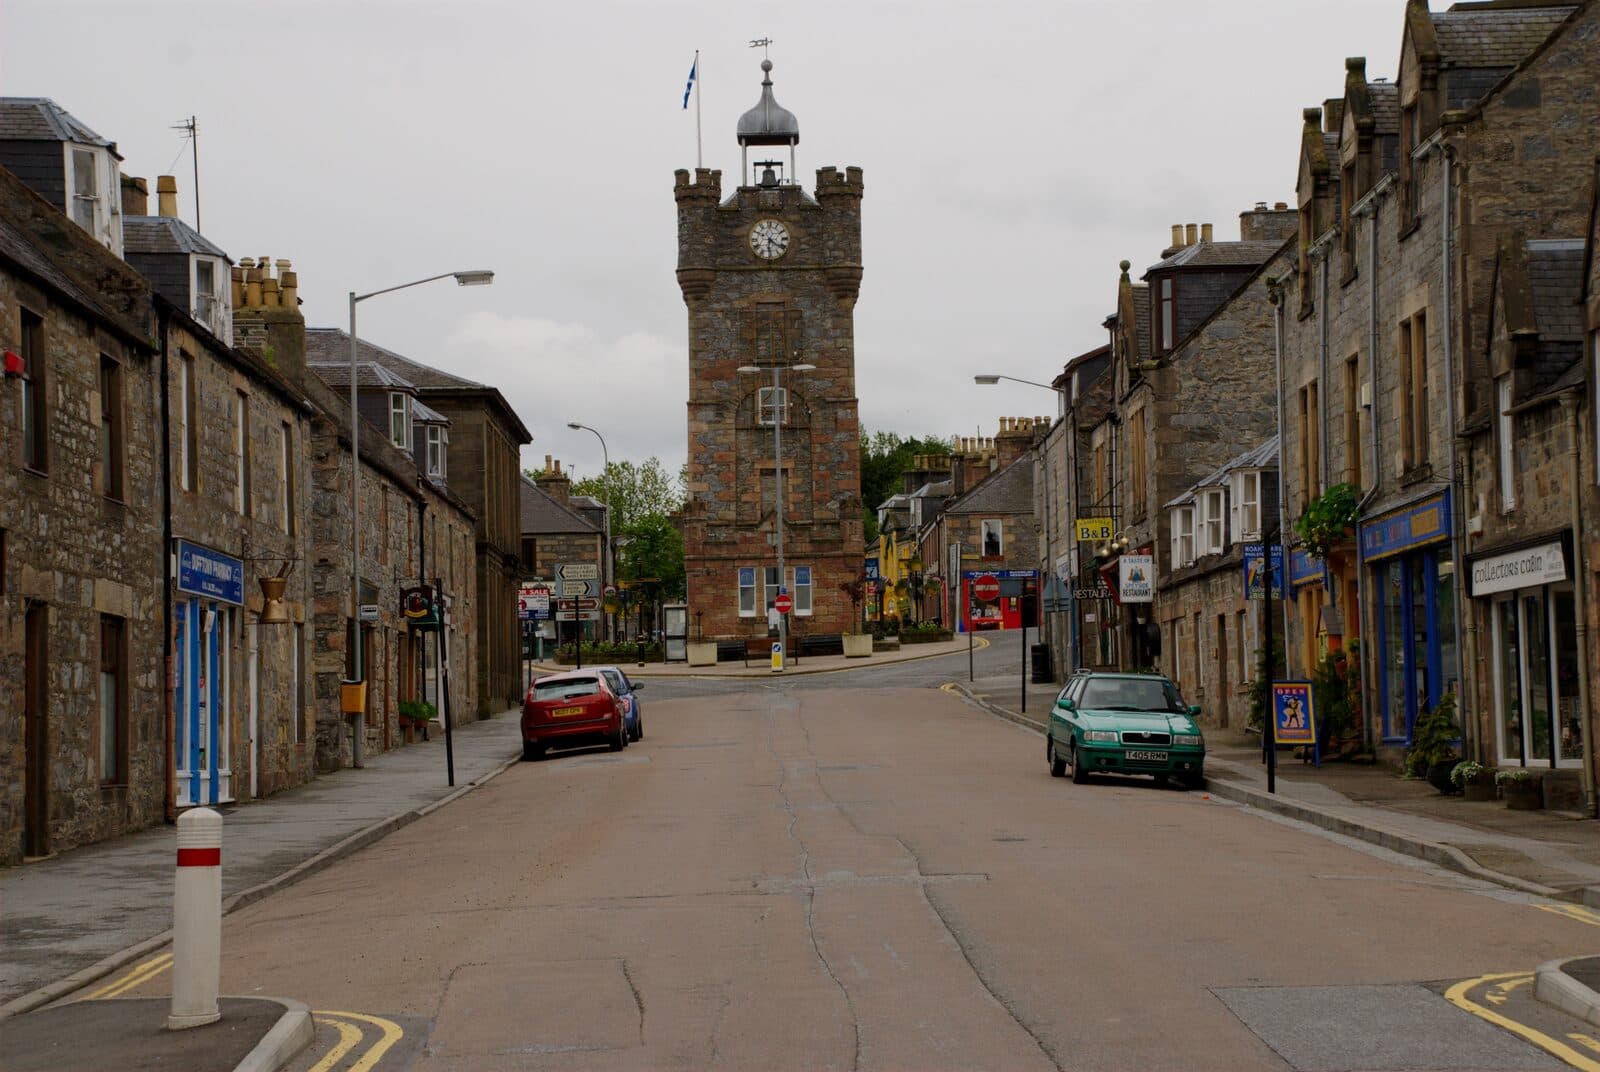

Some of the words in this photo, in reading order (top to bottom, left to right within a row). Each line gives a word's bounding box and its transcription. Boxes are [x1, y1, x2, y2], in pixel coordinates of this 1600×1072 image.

[1081, 528, 1090, 539] B
[1101, 527, 1110, 538] B
[1073, 587, 1112, 599] RESTAURA
[1122, 589, 1151, 597] RESTAURANT
